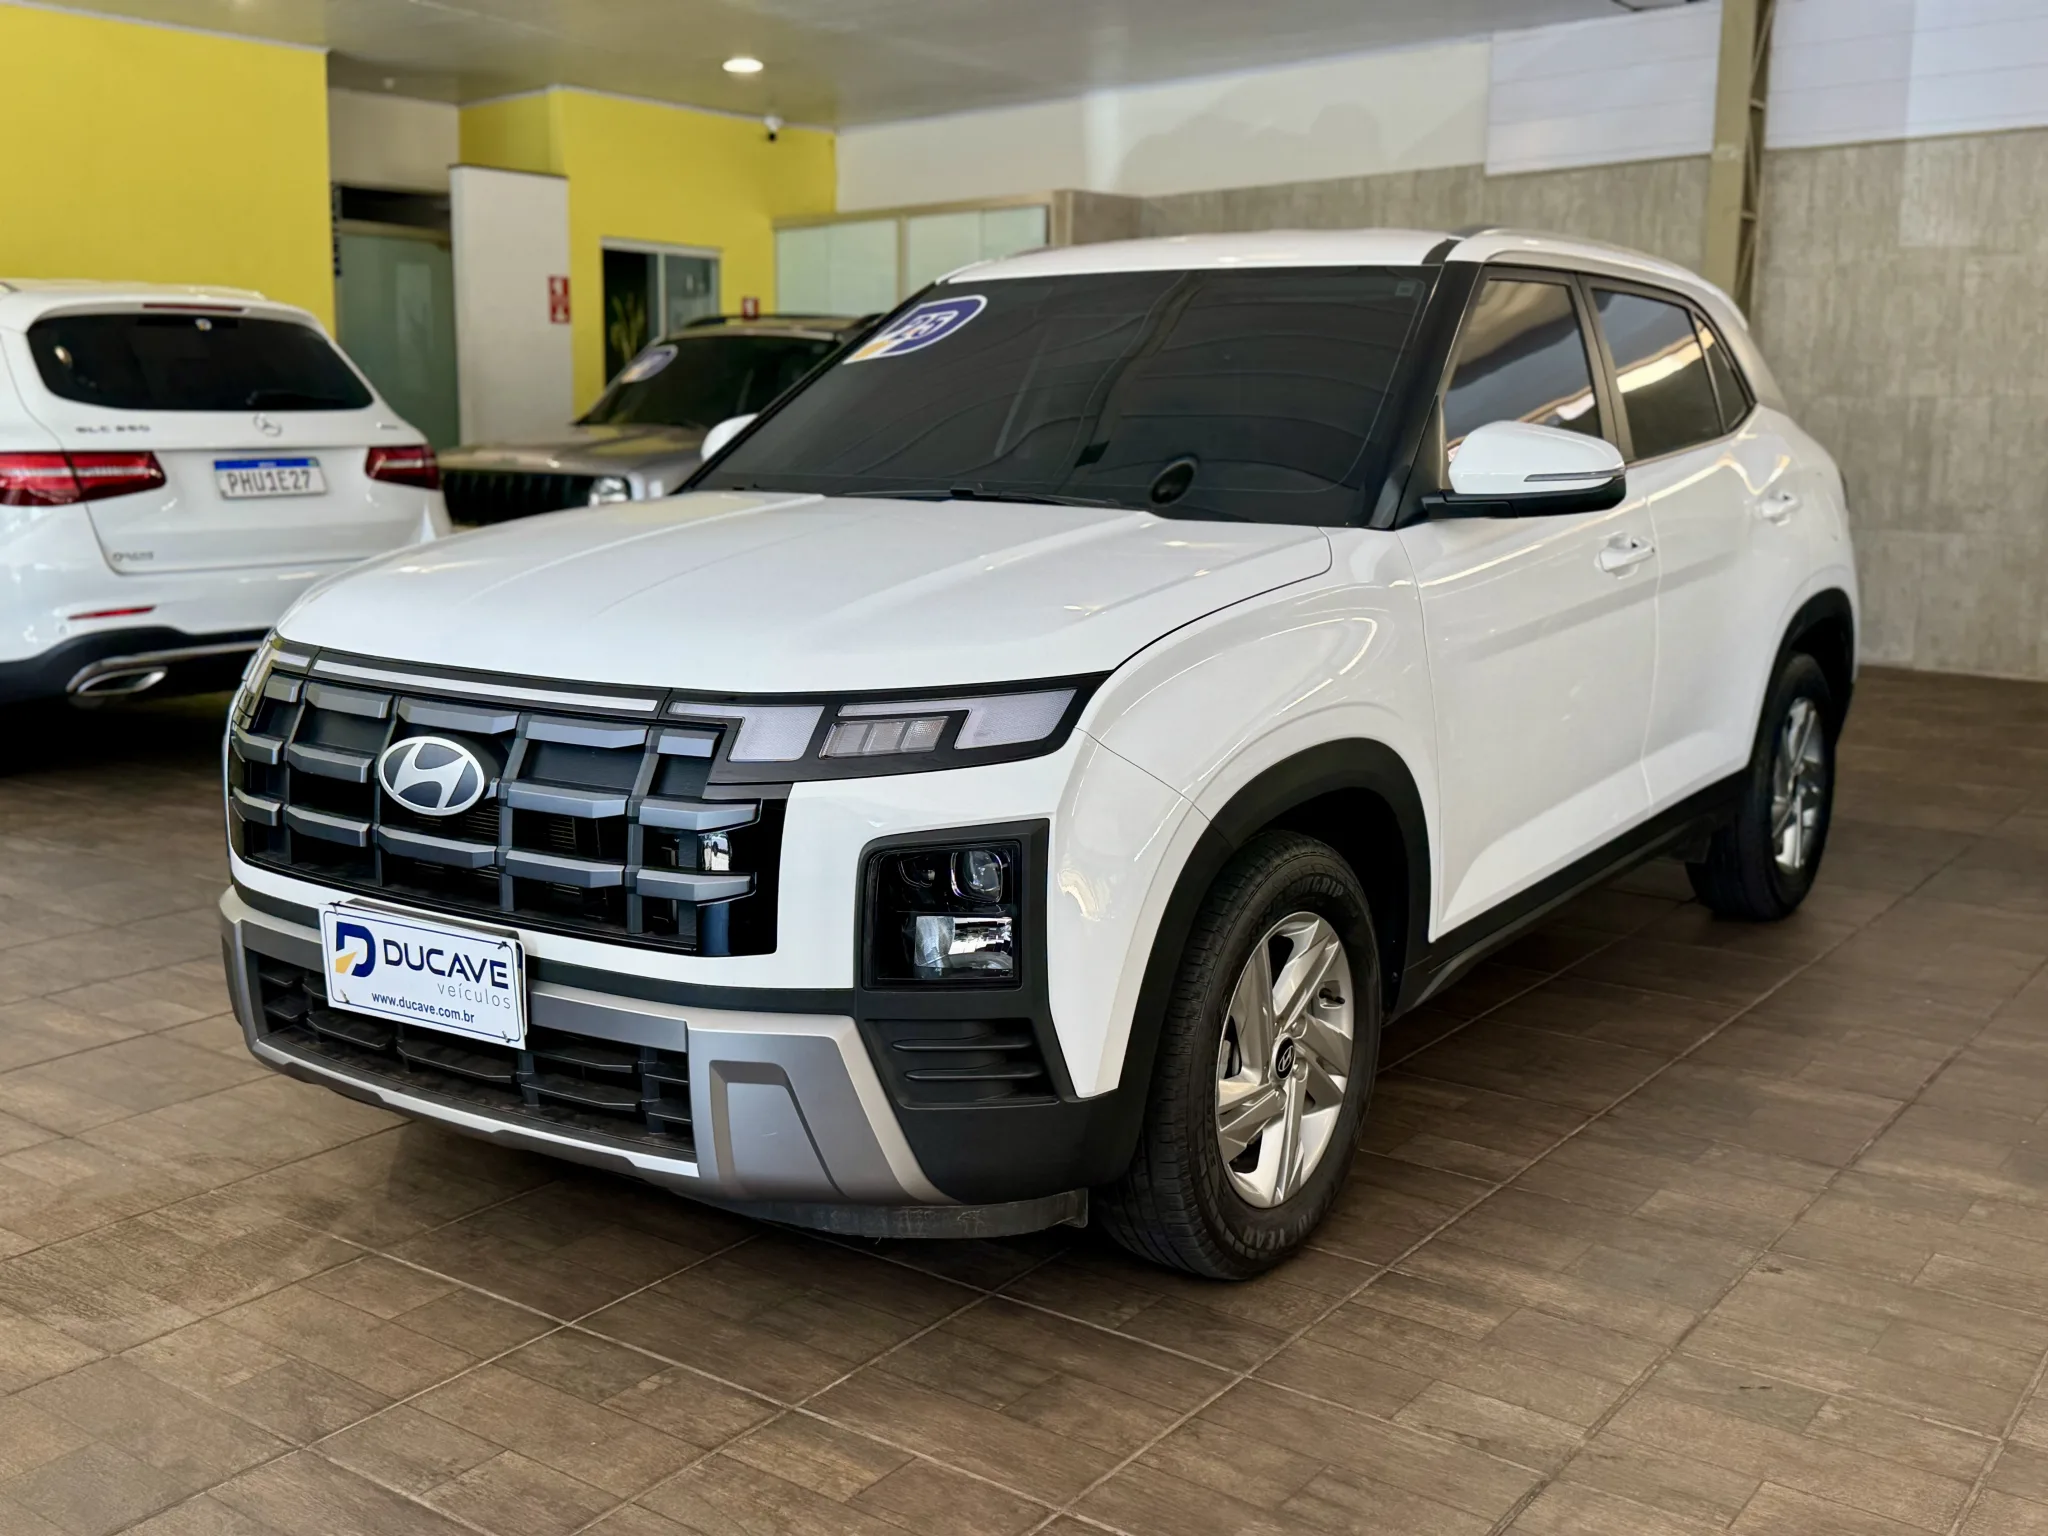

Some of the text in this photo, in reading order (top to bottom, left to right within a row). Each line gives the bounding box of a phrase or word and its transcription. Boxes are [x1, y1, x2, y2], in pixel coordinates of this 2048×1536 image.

[227, 469, 310, 493] PHU1E27
[383, 938, 509, 990] DUCAVE
[371, 991, 475, 1024] www.ducave.com.br
[437, 982, 511, 1010] veículos
